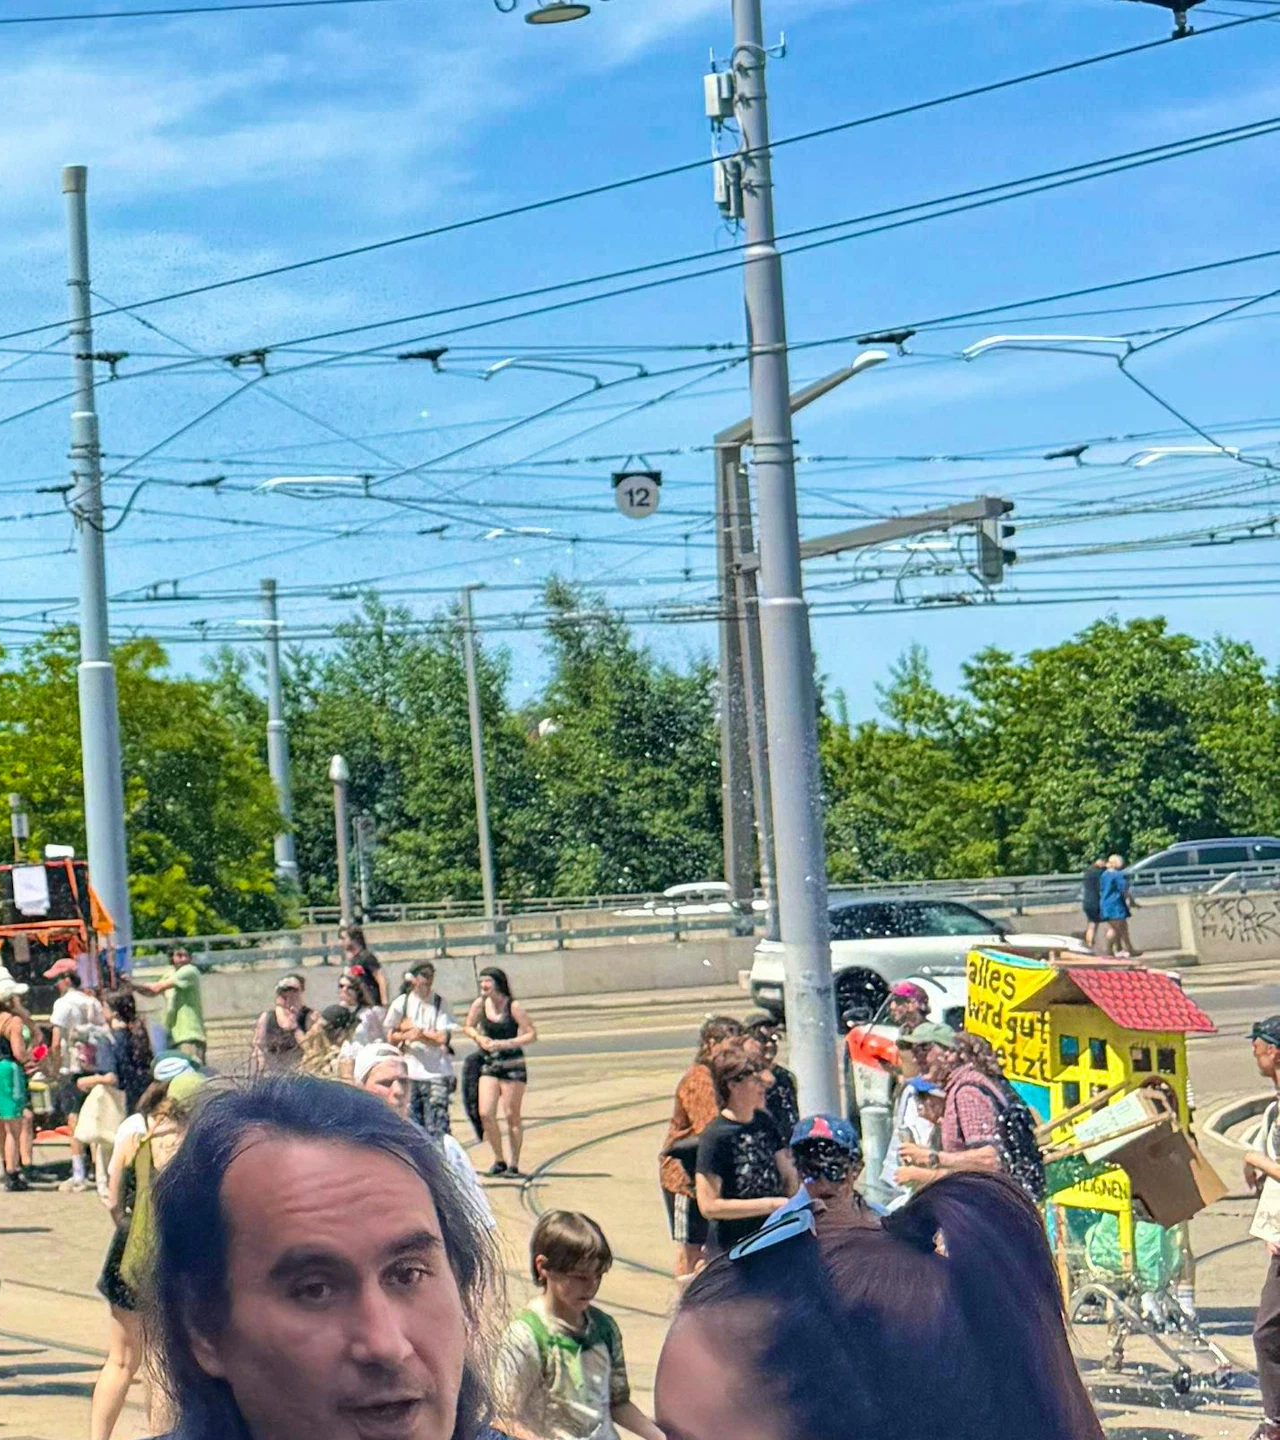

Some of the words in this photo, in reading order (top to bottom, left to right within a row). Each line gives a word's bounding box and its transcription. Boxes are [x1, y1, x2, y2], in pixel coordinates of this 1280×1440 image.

[623, 487, 651, 507] 12
[968, 957, 1017, 1001] alles
[968, 996, 1005, 1030] wird
[1006, 1013, 1049, 1045] gut
